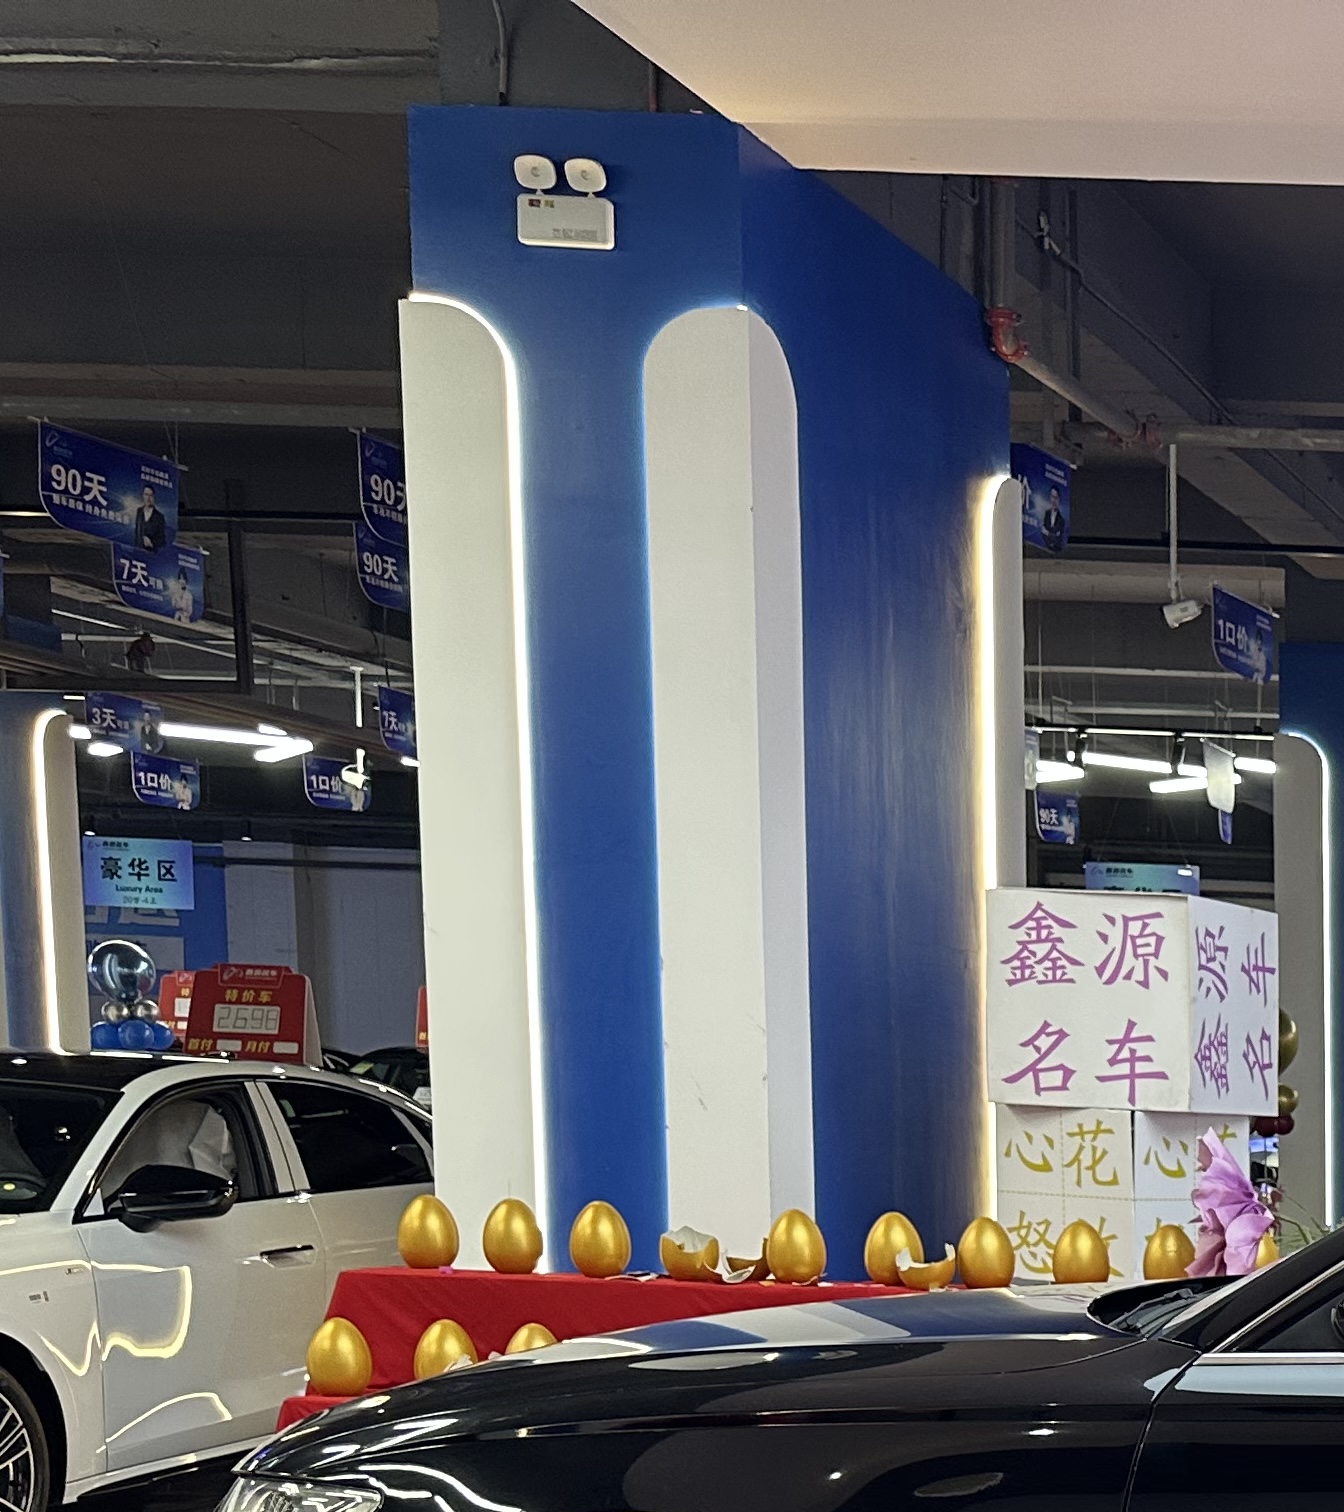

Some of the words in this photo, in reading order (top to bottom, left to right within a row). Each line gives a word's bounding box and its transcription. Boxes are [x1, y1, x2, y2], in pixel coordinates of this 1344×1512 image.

[50, 463, 108, 507] 90天
[363, 551, 399, 582] 90天
[138, 772, 172, 792] 1口价
[310, 773, 344, 793] 1口价
[101, 856, 178, 881] 豪华区
[115, 884, 143, 894] Luxury
[144, 885, 163, 894] Area
[1000, 901, 1170, 990] 鑫源
[225, 988, 273, 1004] 特价车
[1002, 1018, 1170, 1107] 名车
[1004, 1119, 1120, 1188] 心花
